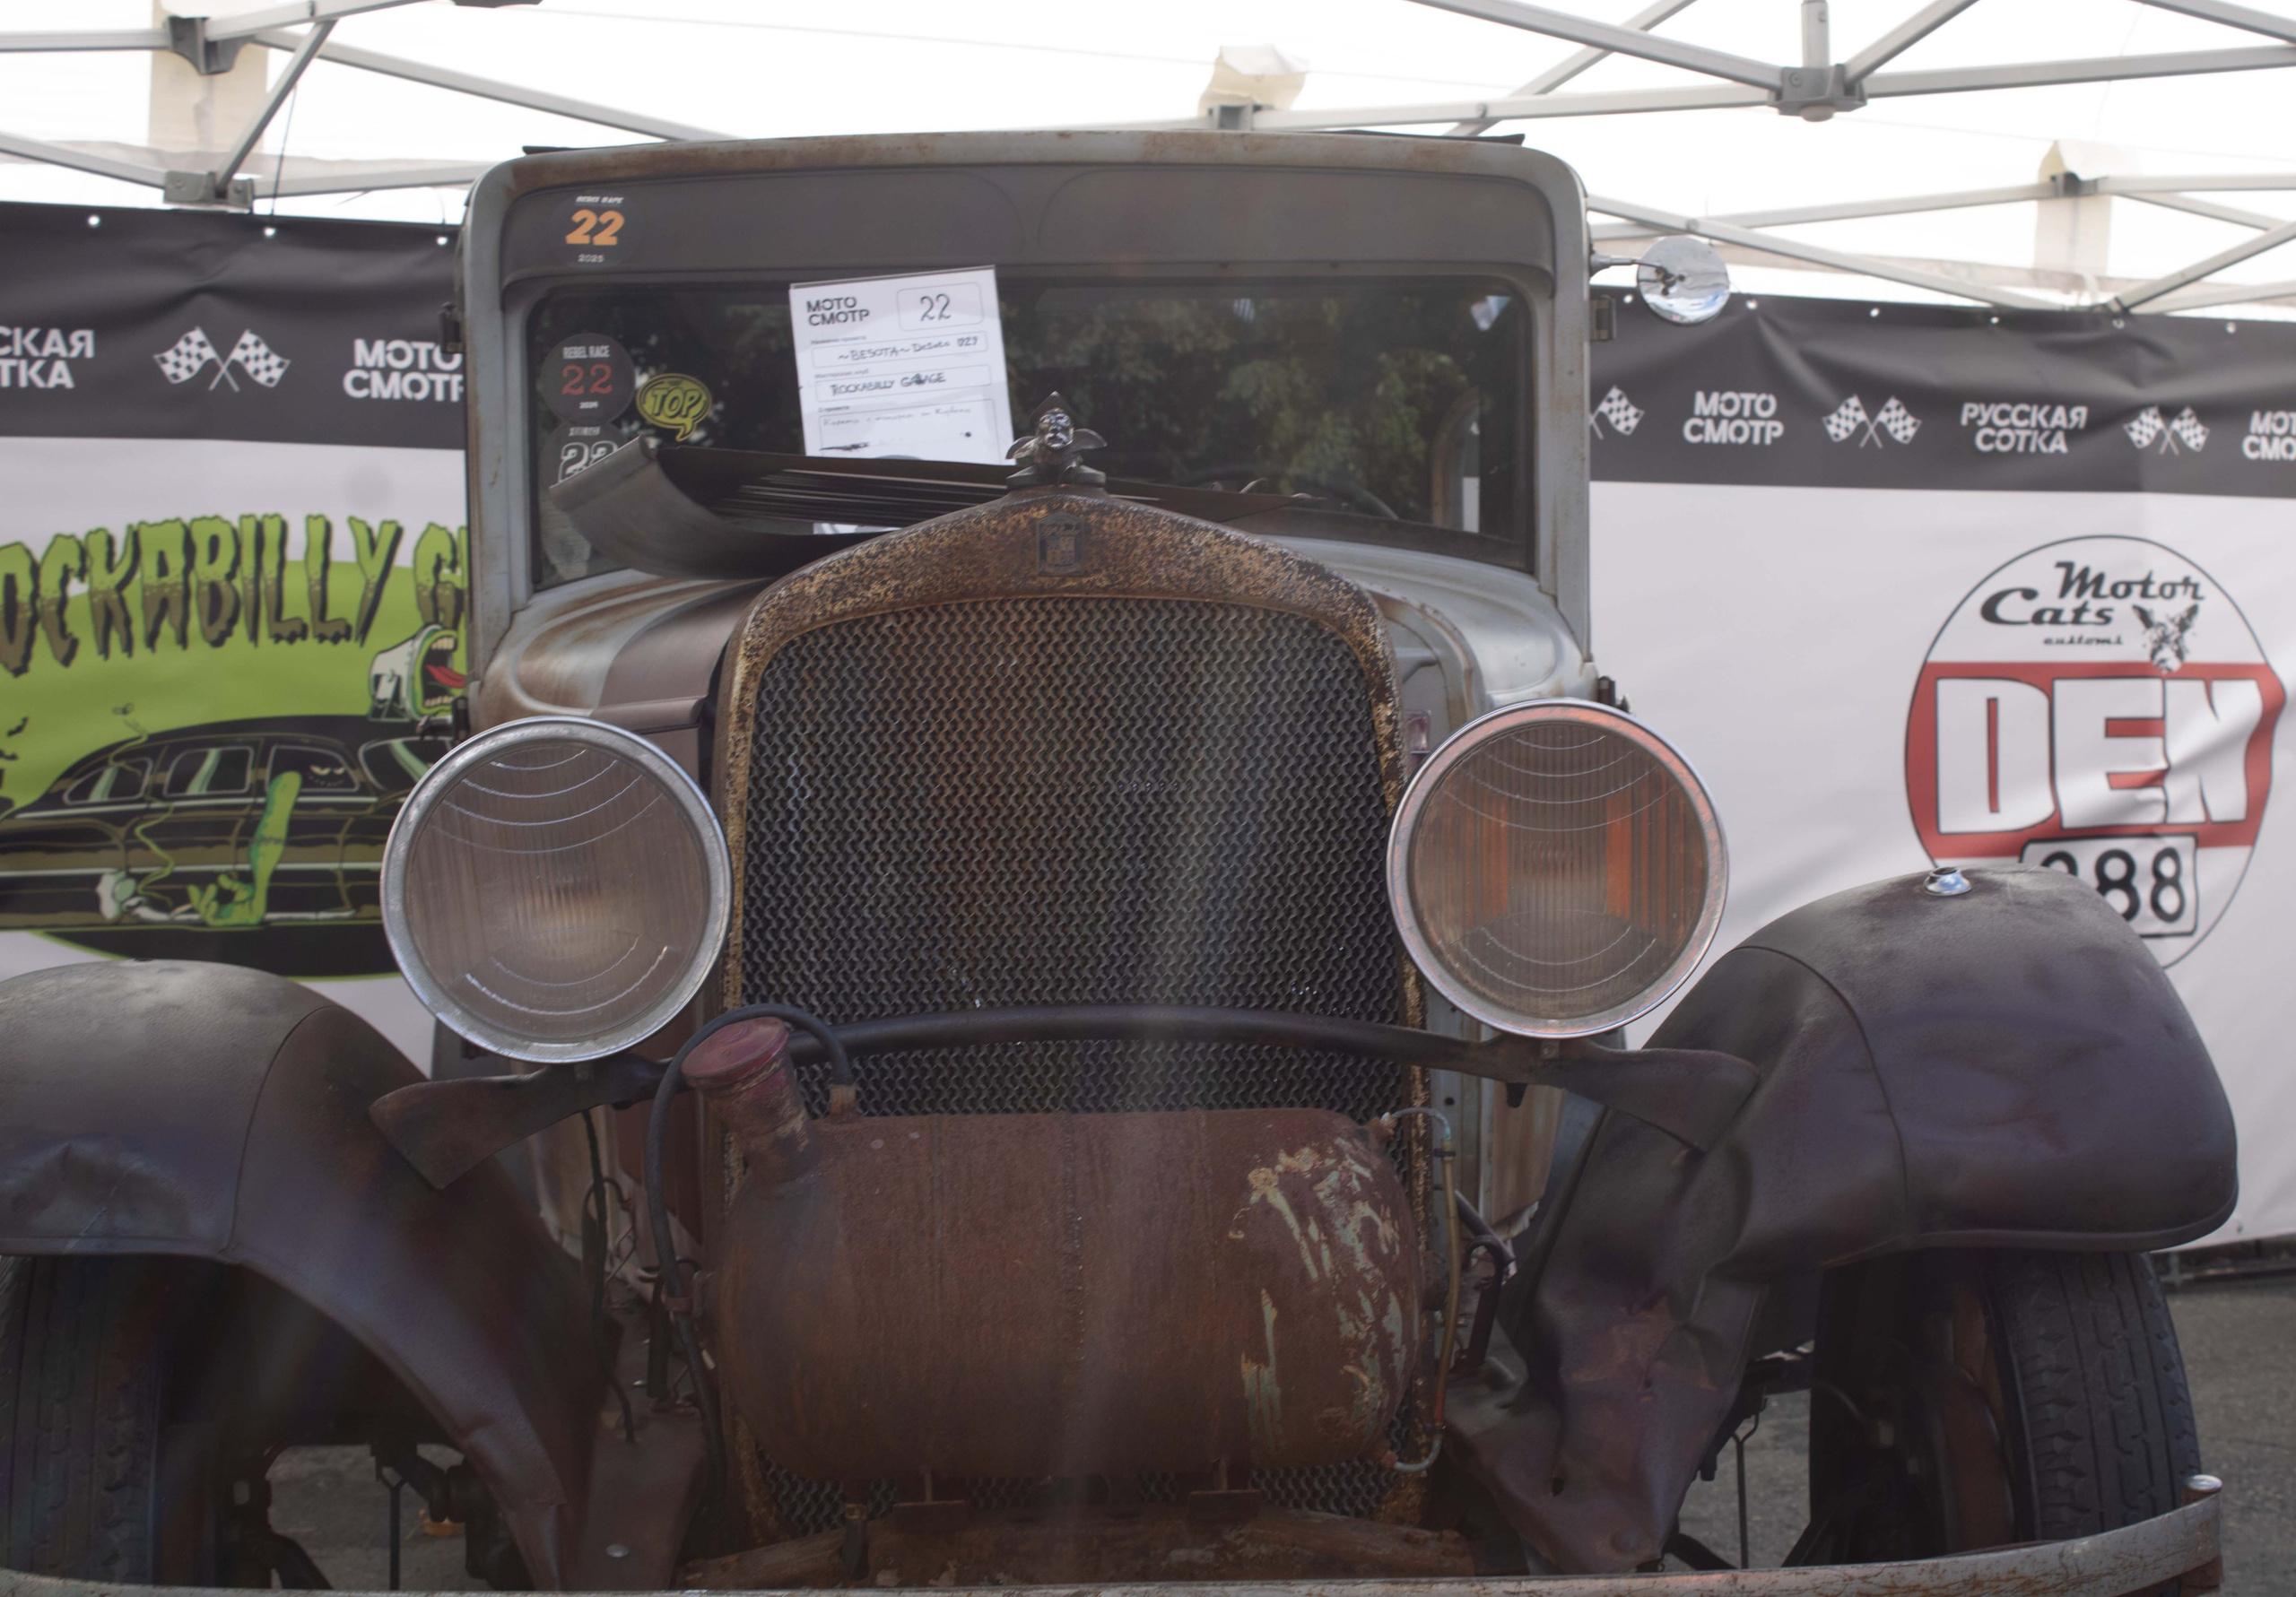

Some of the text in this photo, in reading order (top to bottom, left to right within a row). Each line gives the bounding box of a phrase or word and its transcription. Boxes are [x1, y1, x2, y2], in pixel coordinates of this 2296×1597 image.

[565, 208, 626, 246] 22
[806, 295, 857, 314] МОТО
[808, 308, 870, 328] СМОТР
[919, 292, 952, 323] 22
[561, 362, 613, 395] 22
[651, 386, 703, 420] TOP
[1693, 391, 1777, 421] МОТО
[1959, 402, 2089, 431] РУССКАЯ
[1683, 417, 1784, 446] СМОТР
[1974, 429, 2070, 455] СОТКА
[2055, 560, 2206, 601] Motor
[1980, 586, 2115, 627] Cats
[1935, 676, 2265, 835] DEN
[2040, 846, 2186, 923] 88
